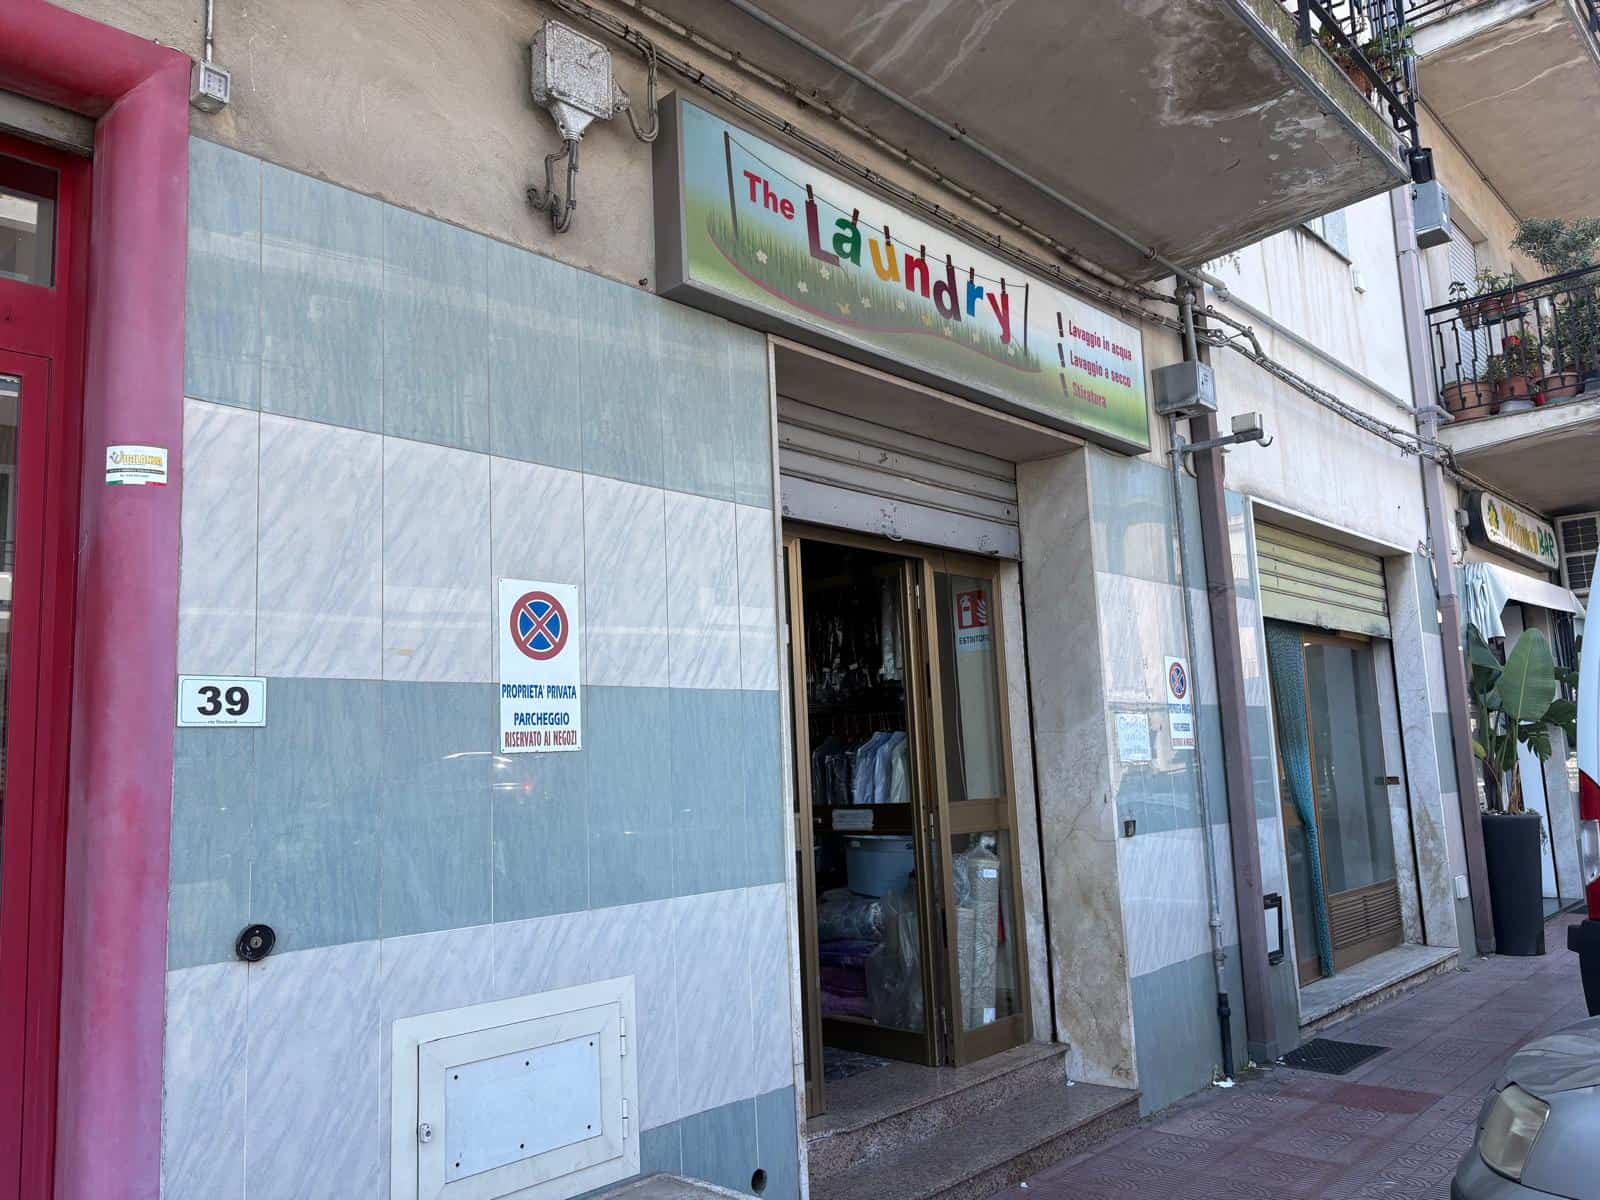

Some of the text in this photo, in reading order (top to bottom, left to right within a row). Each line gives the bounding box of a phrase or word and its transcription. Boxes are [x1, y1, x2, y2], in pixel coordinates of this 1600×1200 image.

[743, 169, 1012, 344] The Laundry
[1069, 320, 1132, 361] Lavaggio in acqua
[1070, 350, 1132, 388] Lavaggio a secco
[1537, 526, 1556, 562] BAR
[197, 685, 250, 716] 39
[547, 685, 577, 699] PRIVATA
[514, 712, 570, 726] PARCHEGGIO
[505, 730, 577, 747] RISERVATO AI NEGOZI
